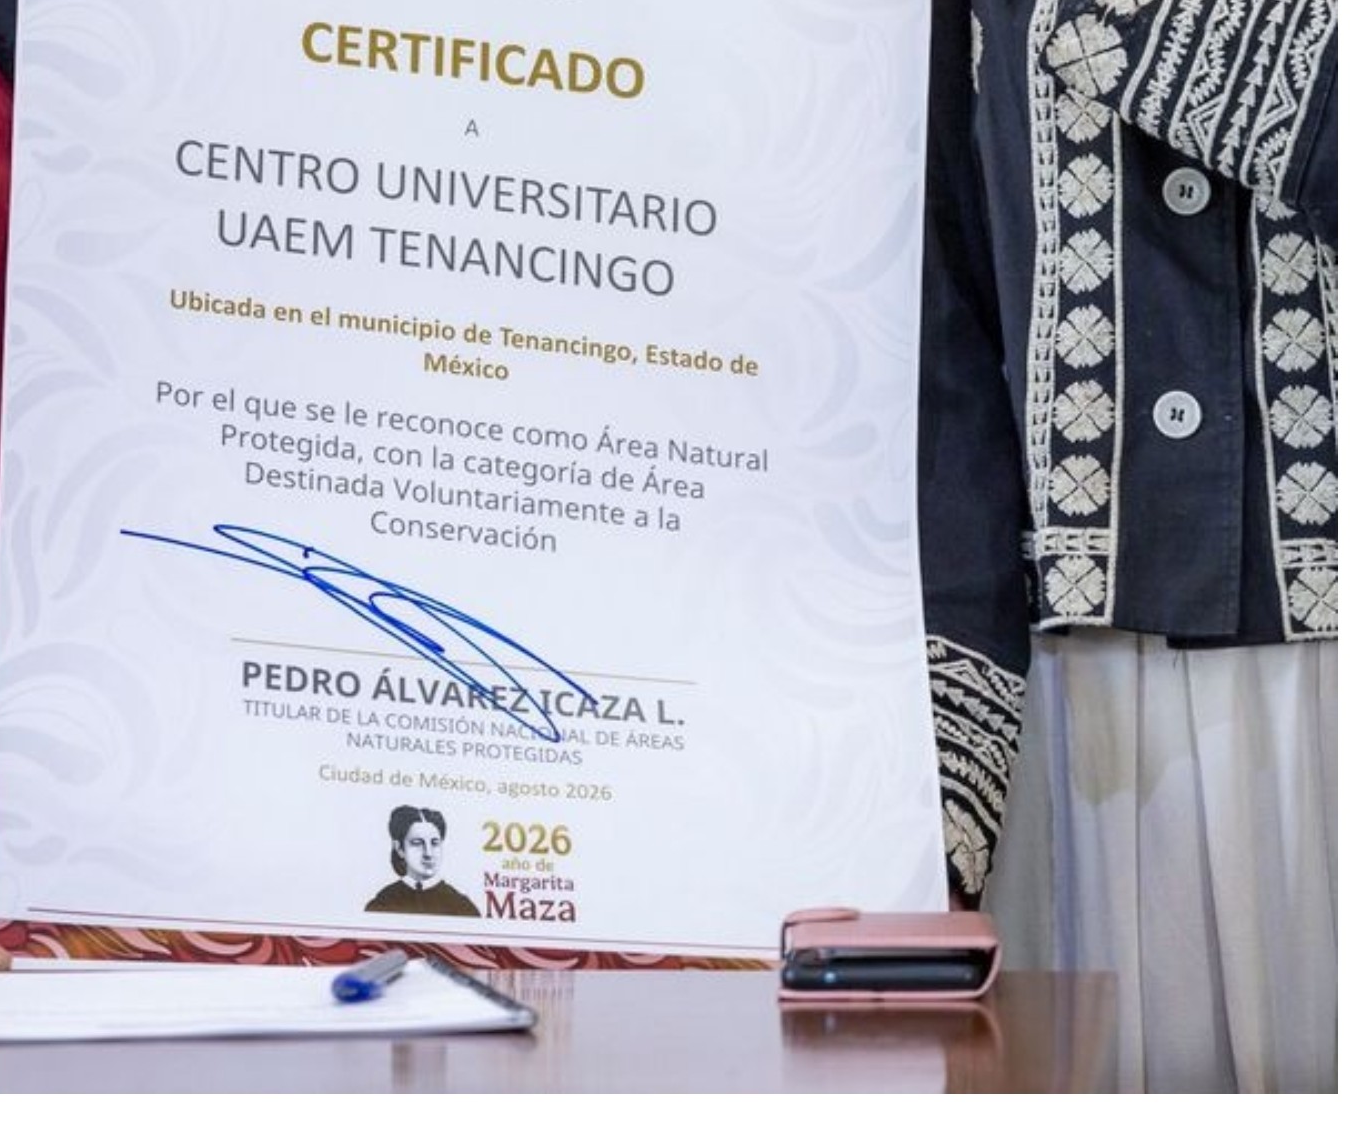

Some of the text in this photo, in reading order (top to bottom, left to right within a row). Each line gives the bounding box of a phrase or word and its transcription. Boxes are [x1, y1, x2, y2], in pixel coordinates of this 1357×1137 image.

[302, 22, 644, 98] CERTIFICADO
[464, 119, 479, 137] A
[176, 140, 716, 236] CENTRO UNIVERSITARIO
[218, 209, 674, 296] UAEM TENANCINGO
[170, 289, 758, 376] Ubicada en el municipio de Tenancingo, Estado de
[424, 352, 509, 380] México
[156, 380, 768, 472] Por el que se le reconoce como Área Natural
[222, 424, 704, 499] Protegida, con la categoría de Área
[245, 462, 680, 532] Destinada Voluntariamente a la
[371, 510, 556, 552] Conservación
[242, 660, 685, 726] PEDRO ÁLVAREZ ICAZA L.
[244, 700, 321, 722] TITULAR
[327, 707, 351, 725] DE
[357, 711, 380, 727] LA
[386, 713, 484, 736] COMISIÓN
[596, 731, 619, 747] DE
[626, 729, 685, 750] ÁREAS
[346, 732, 583, 766] NATURALES PROTEGIDAS
[318, 764, 612, 800] Ciudad de México, agosto 2026
[482, 821, 572, 856] 2026
[484, 872, 574, 894] Margarita
[502, 856, 554, 872] año de
[484, 891, 577, 923] Maza
